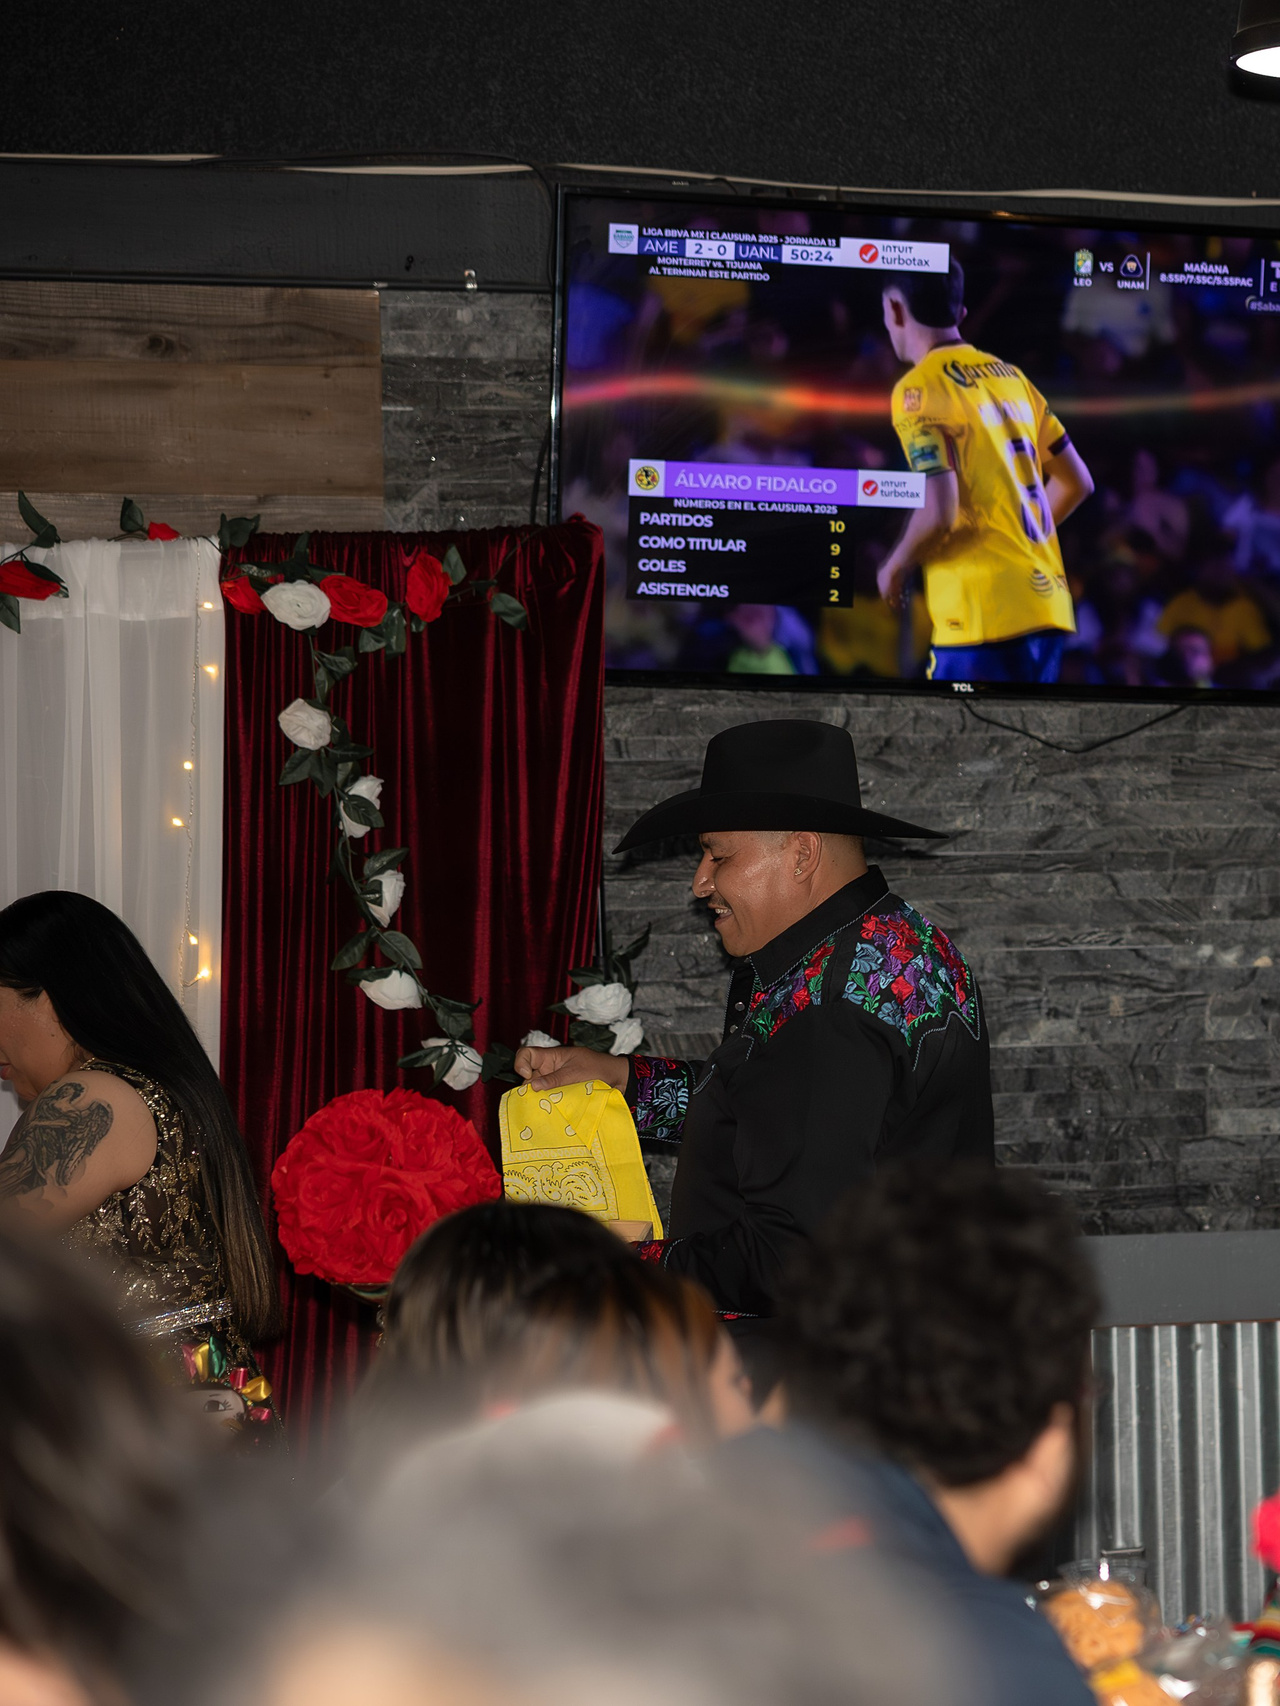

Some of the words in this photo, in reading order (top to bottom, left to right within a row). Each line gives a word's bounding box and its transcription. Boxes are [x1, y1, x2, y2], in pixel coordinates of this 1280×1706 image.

[642, 227, 663, 236] LIGA
[664, 228, 689, 238] BBVA
[690, 230, 704, 239] MX
[710, 232, 757, 242] CLAUSURA
[758, 234, 778, 243] 2025
[784, 236, 827, 246] JORNADA
[828, 238, 836, 246] 13
[644, 240, 678, 254] AME
[694, 242, 703, 255] 2
[717, 244, 727, 256] 0
[739, 245, 779, 260] UANL
[790, 248, 834, 262] 50:24
[881, 255, 930, 267] turbotax
[657, 256, 711, 268] MONTERREY
[725, 261, 763, 271] TIJUANA
[1099, 262, 1114, 273] VS
[1183, 261, 1230, 275] MAÑANA
[649, 266, 661, 275] AL
[661, 267, 707, 278] TERMINAR
[708, 270, 730, 279] ESTE
[730, 271, 770, 281] PARTIDO
[1073, 277, 1092, 287] LEO
[1117, 280, 1145, 290] UNAM
[674, 469, 752, 491] ÁLVARO
[756, 475, 837, 494] FIDALGO
[880, 489, 920, 499] turbotax
[673, 498, 726, 510] NÚMEROS
[727, 501, 741, 510] EN
[743, 502, 757, 511] EL
[757, 502, 813, 514] CLAUSURA
[813, 504, 838, 515] 2025
[640, 512, 714, 528] PARTIDOS
[829, 520, 845, 533] 10
[638, 535, 685, 549] COMO
[687, 537, 747, 552] TITULAR
[830, 543, 841, 556] 9
[637, 559, 687, 573] GOLES
[829, 566, 840, 579] 5
[636, 582, 729, 598] ASISTENCIAS
[829, 589, 839, 602] 2
[952, 682, 974, 692] TCL
